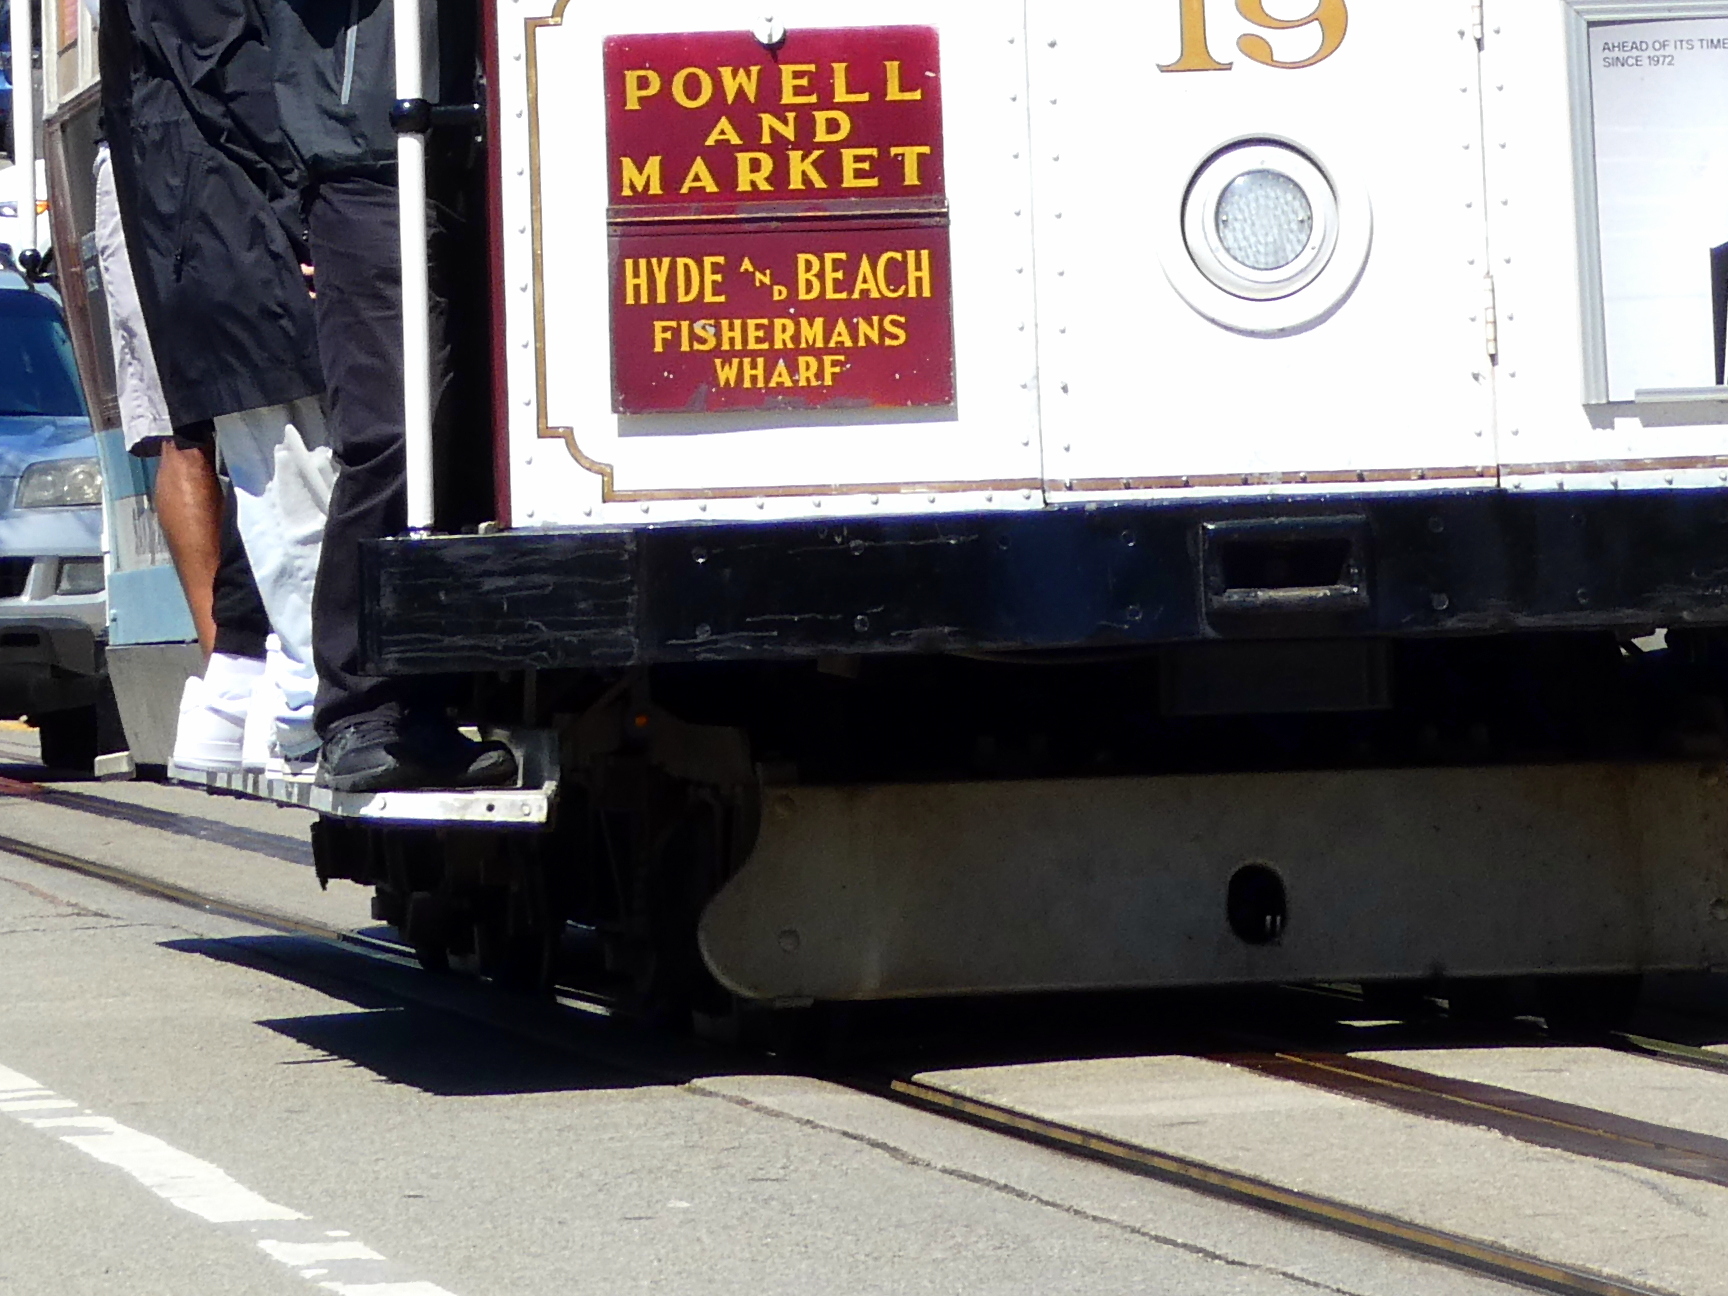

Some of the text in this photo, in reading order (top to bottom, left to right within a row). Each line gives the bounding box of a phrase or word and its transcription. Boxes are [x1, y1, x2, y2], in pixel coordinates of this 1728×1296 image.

[1602, 40, 1649, 53] AHEAD
[1652, 39, 1671, 51] OF
[1674, 39, 1694, 50] ITS
[1603, 55, 1675, 68] SINCE 1972
[624, 61, 922, 110] POWELL
[704, 110, 852, 146] AND
[620, 146, 930, 196] MARKET
[625, 249, 931, 305] HYDE AND BEACH
[652, 314, 907, 352] FISHERMANS
[714, 354, 847, 389] WHARF
